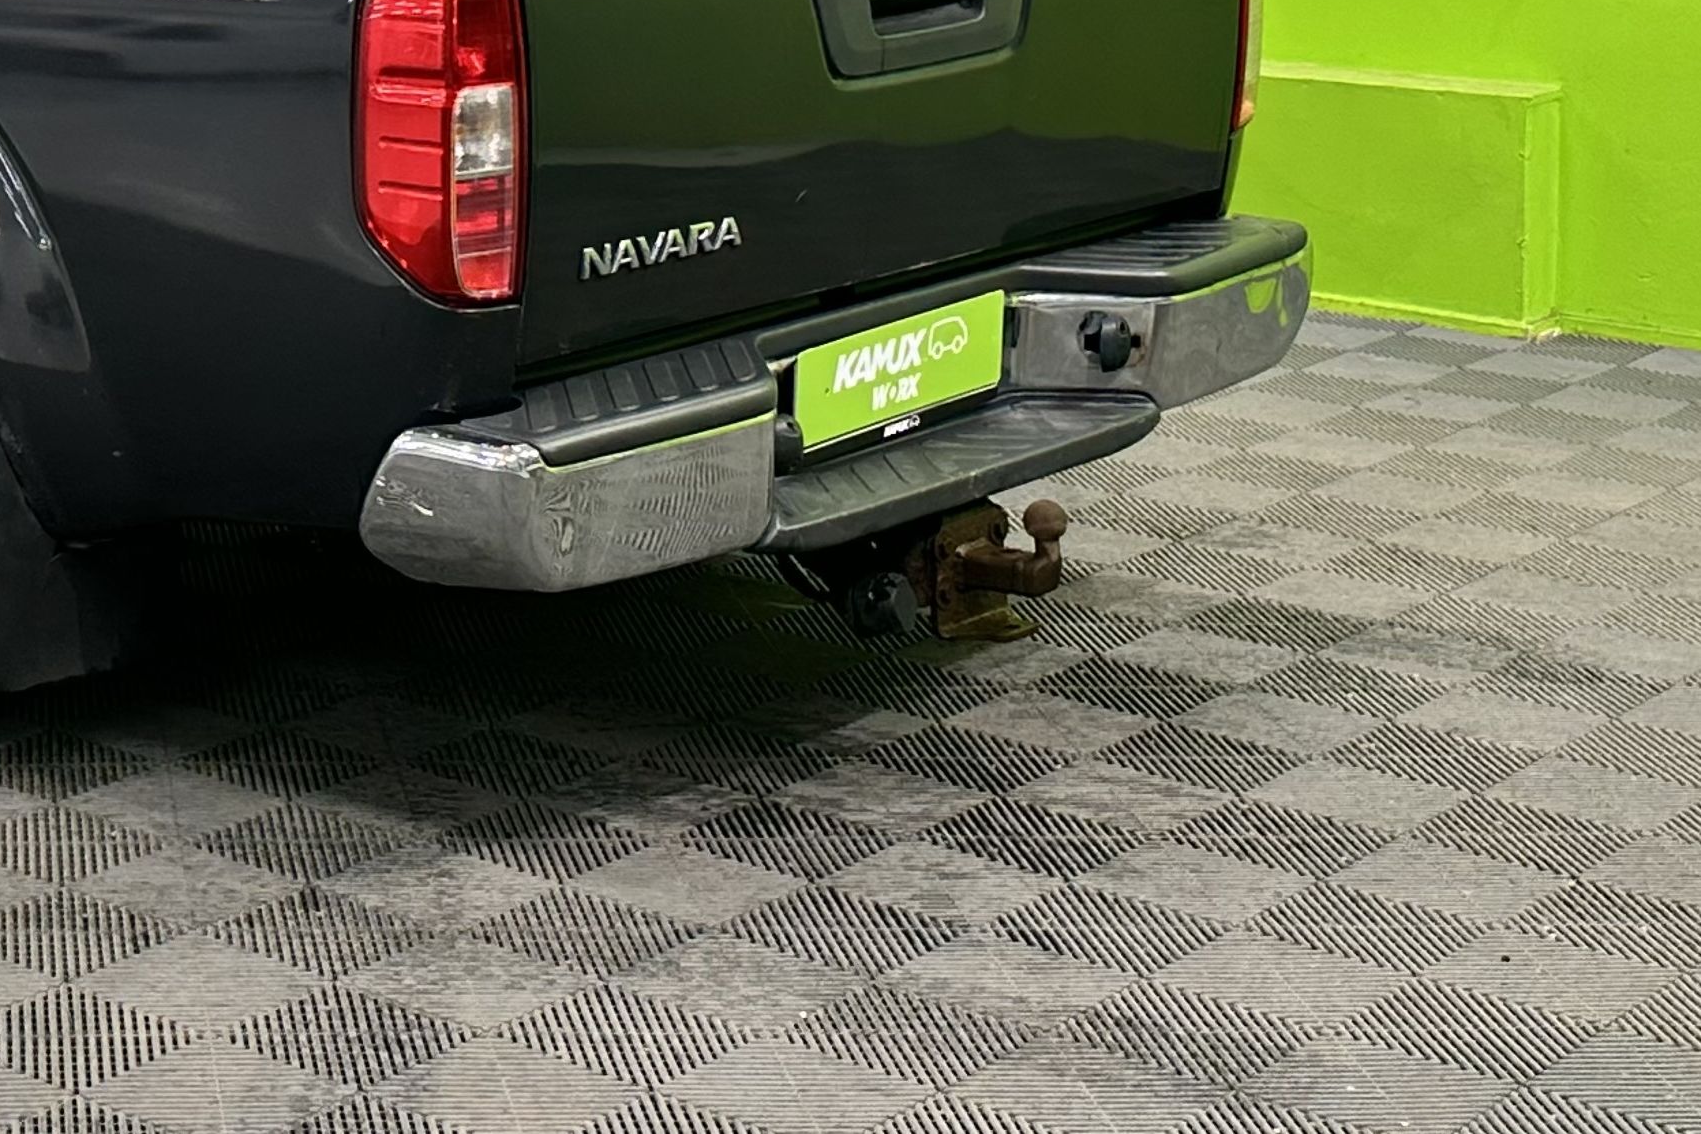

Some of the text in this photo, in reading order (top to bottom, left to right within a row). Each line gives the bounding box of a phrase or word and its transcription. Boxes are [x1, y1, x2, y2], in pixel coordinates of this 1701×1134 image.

[579, 216, 742, 281] NAVARA
[832, 327, 928, 394] KAMUX
[871, 372, 922, 411] WORX
